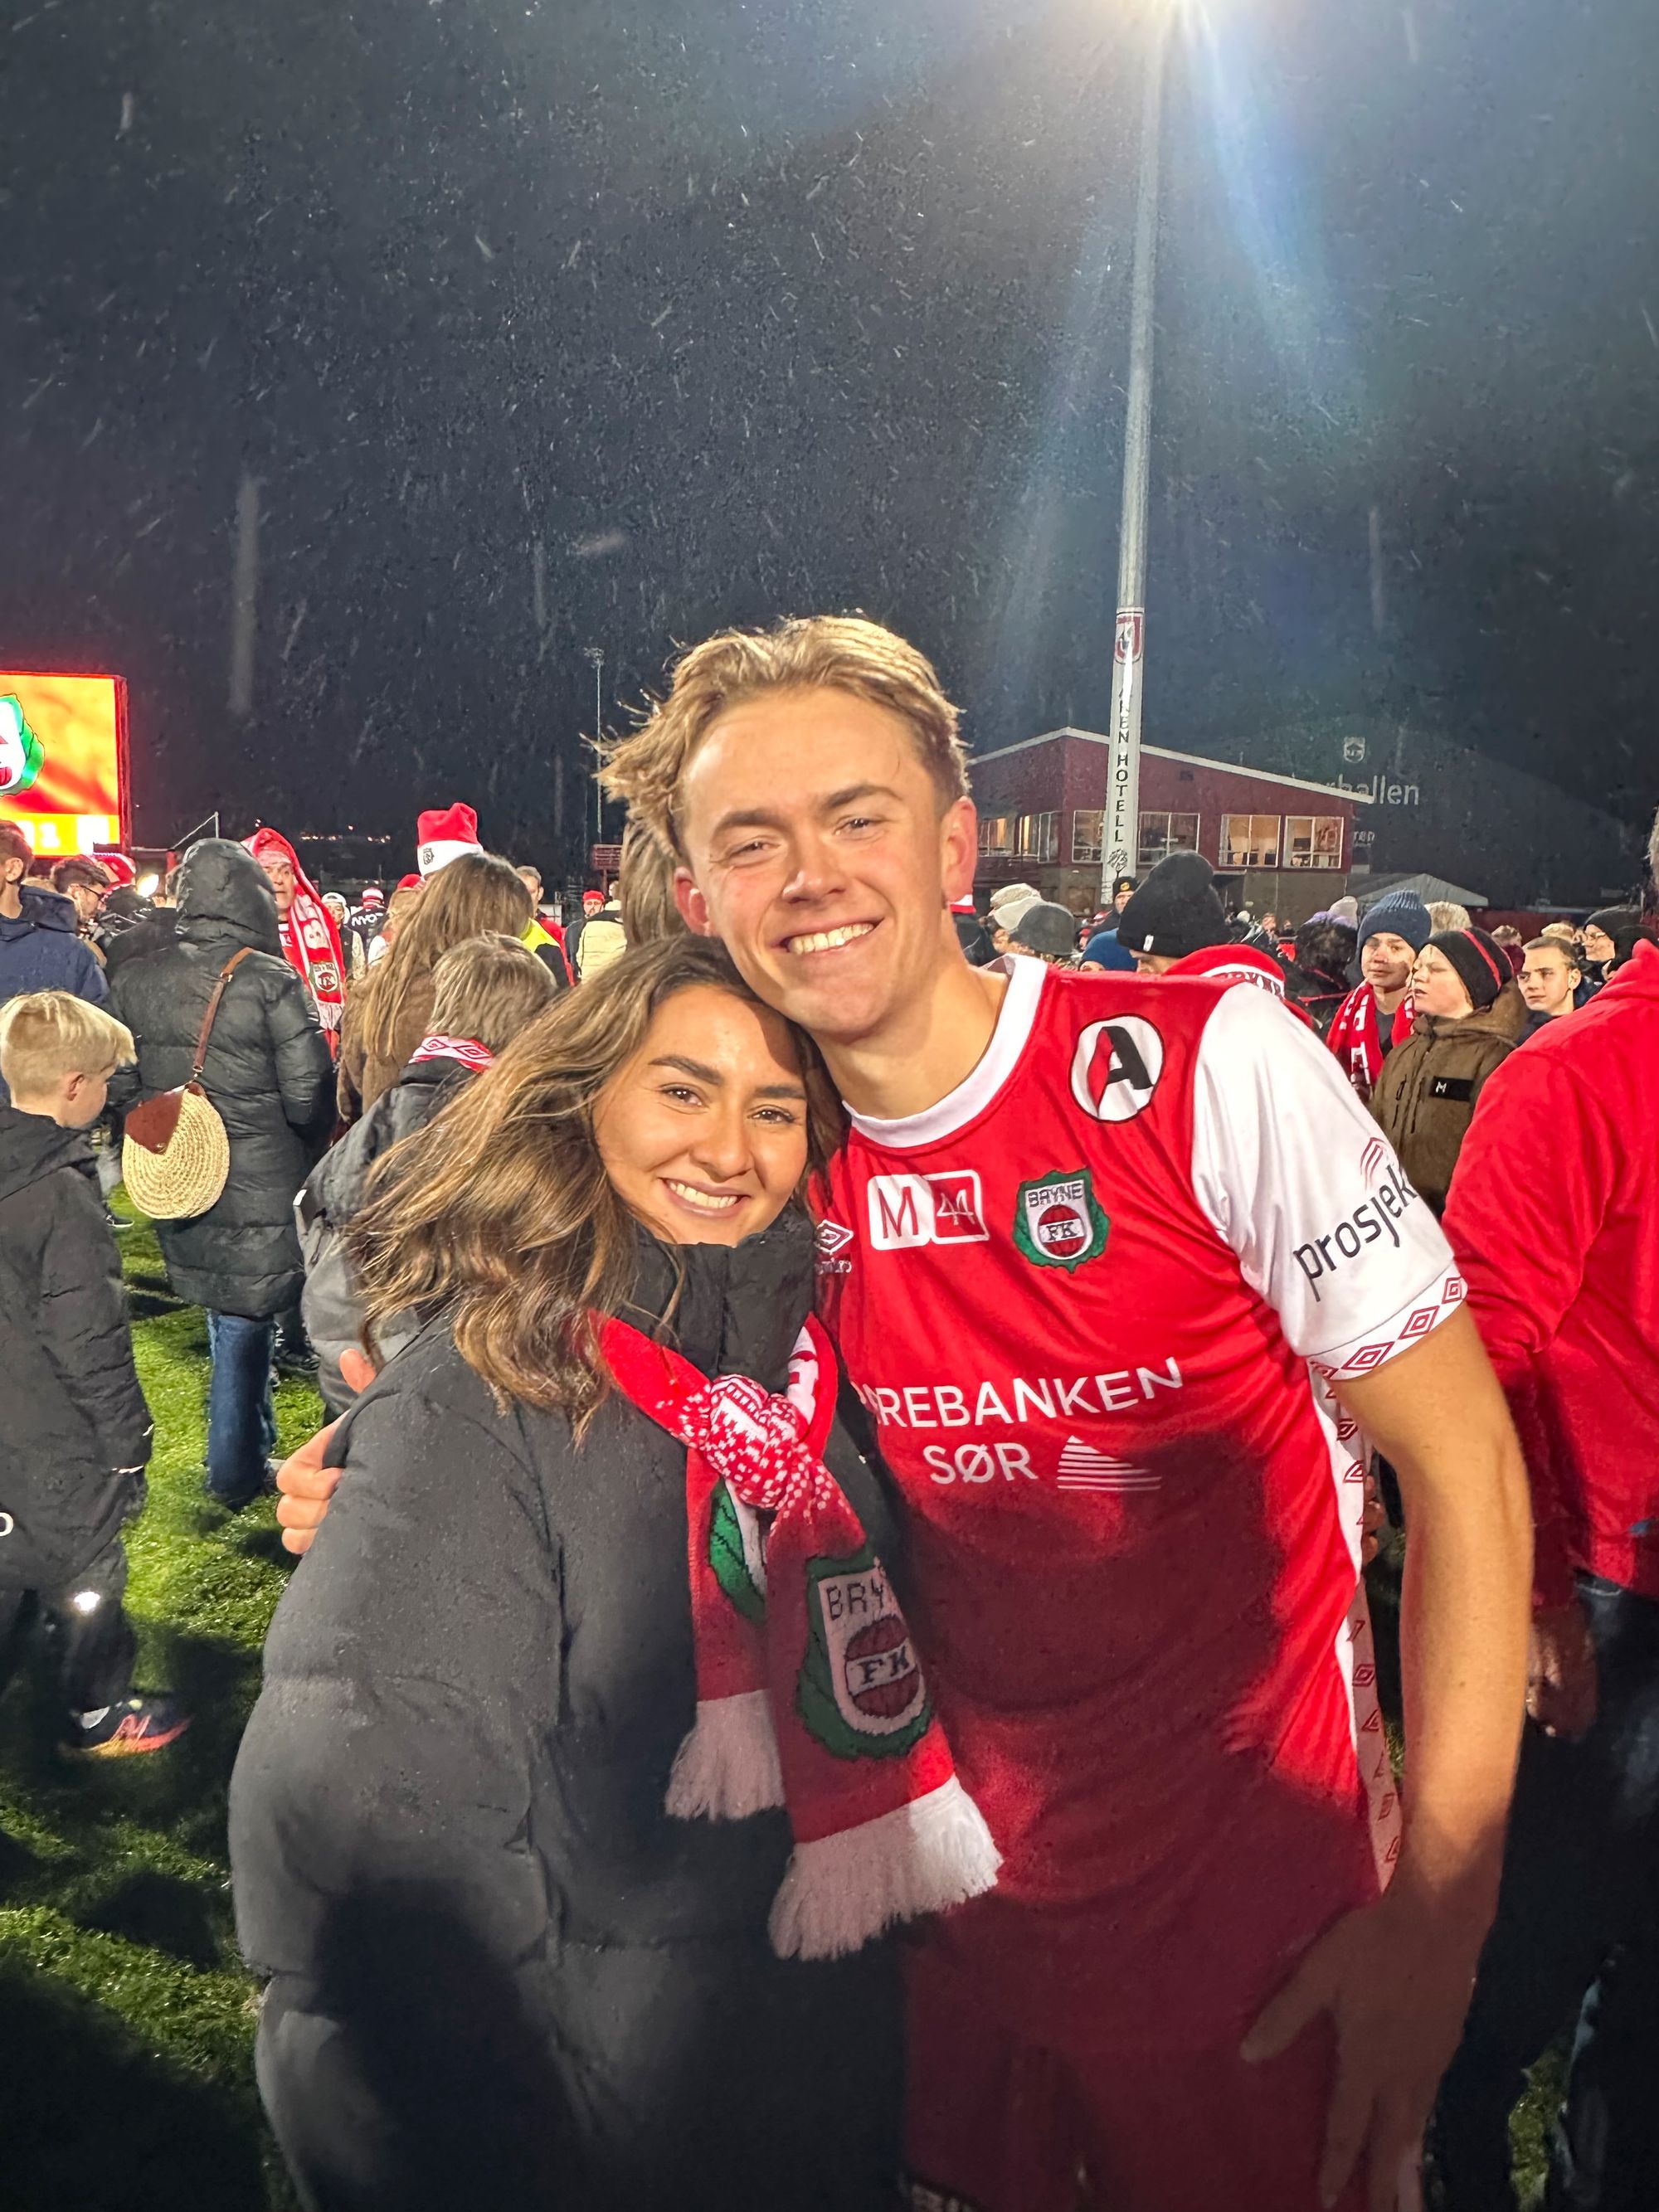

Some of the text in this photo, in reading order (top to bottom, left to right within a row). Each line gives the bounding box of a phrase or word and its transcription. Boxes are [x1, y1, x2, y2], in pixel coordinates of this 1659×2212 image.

[1114, 753, 1128, 842] HOTELL
[1087, 1025, 1154, 1117] A
[1028, 1183, 1083, 1208] BRYNE
[1046, 1221, 1078, 1242] FK
[850, 1356, 1184, 1428] REBANKEN
[922, 1441, 1039, 1485] SØR
[826, 1578, 890, 1621] BRY
[858, 1646, 910, 1685] FK
